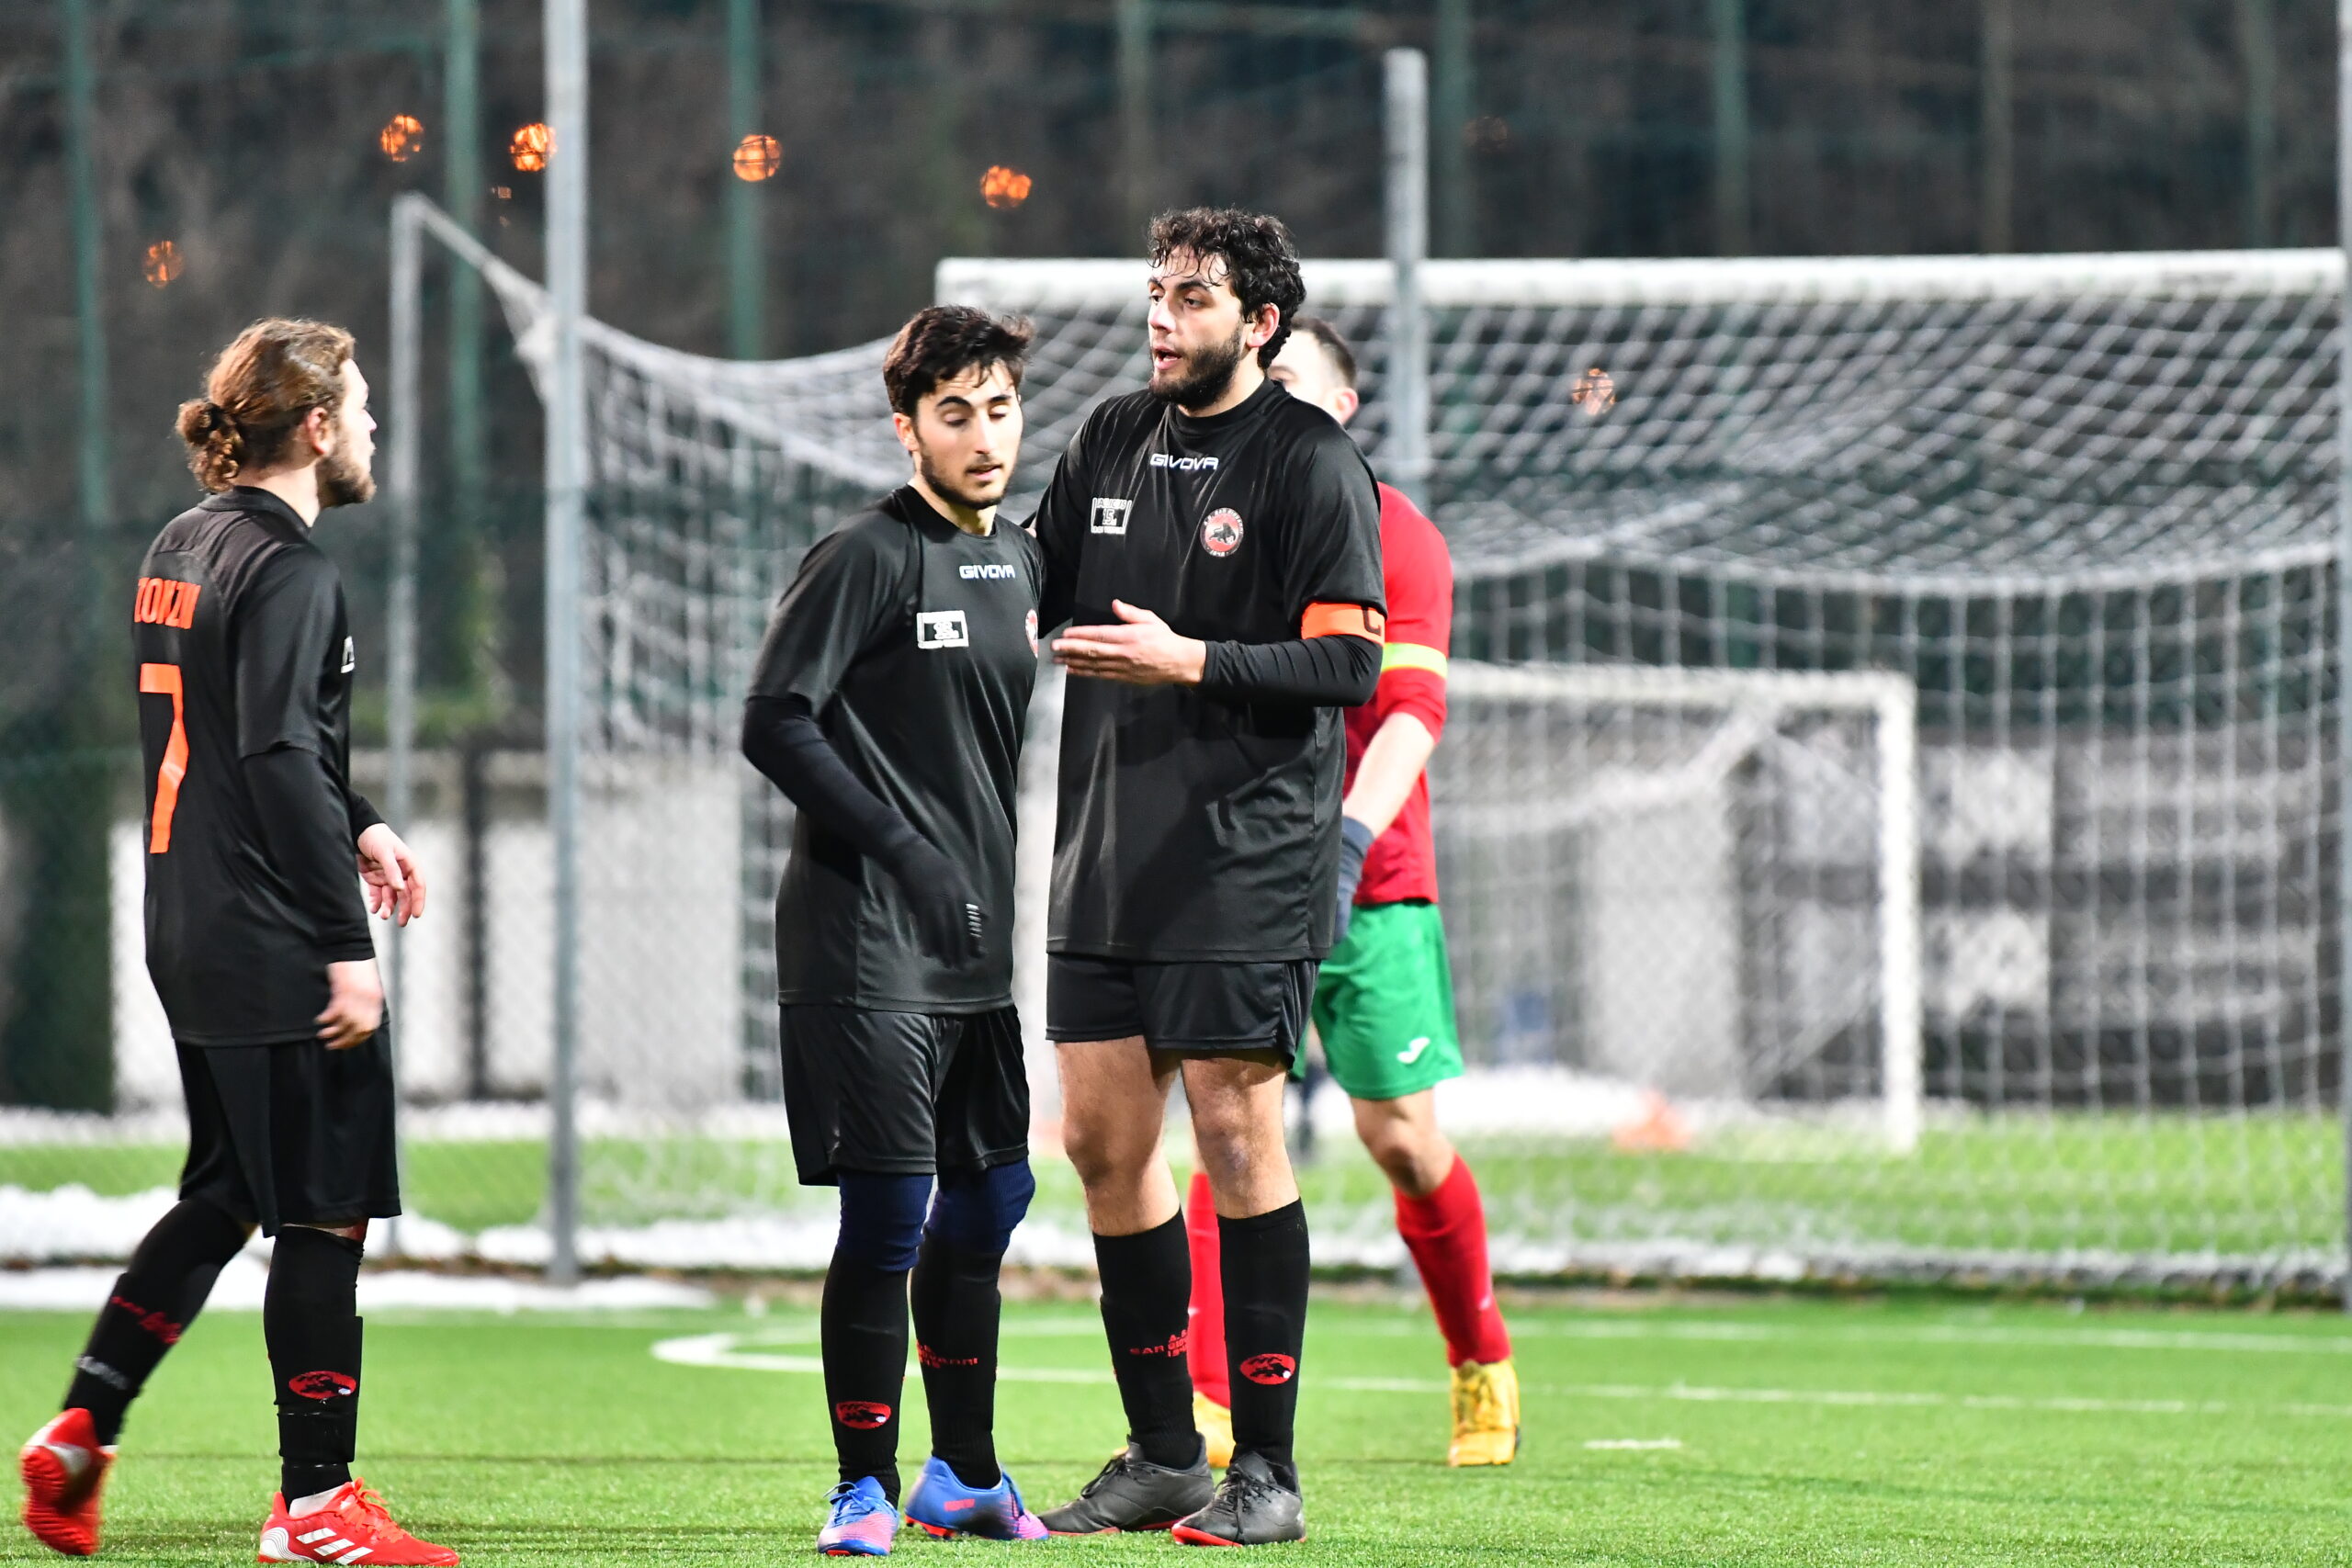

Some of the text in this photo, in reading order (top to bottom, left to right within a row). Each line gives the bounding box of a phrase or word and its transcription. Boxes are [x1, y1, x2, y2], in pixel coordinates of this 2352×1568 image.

[1150, 453, 1219, 470] GIVOVA
[959, 565, 1015, 579] GIVOVA
[139, 662, 190, 853] 7
